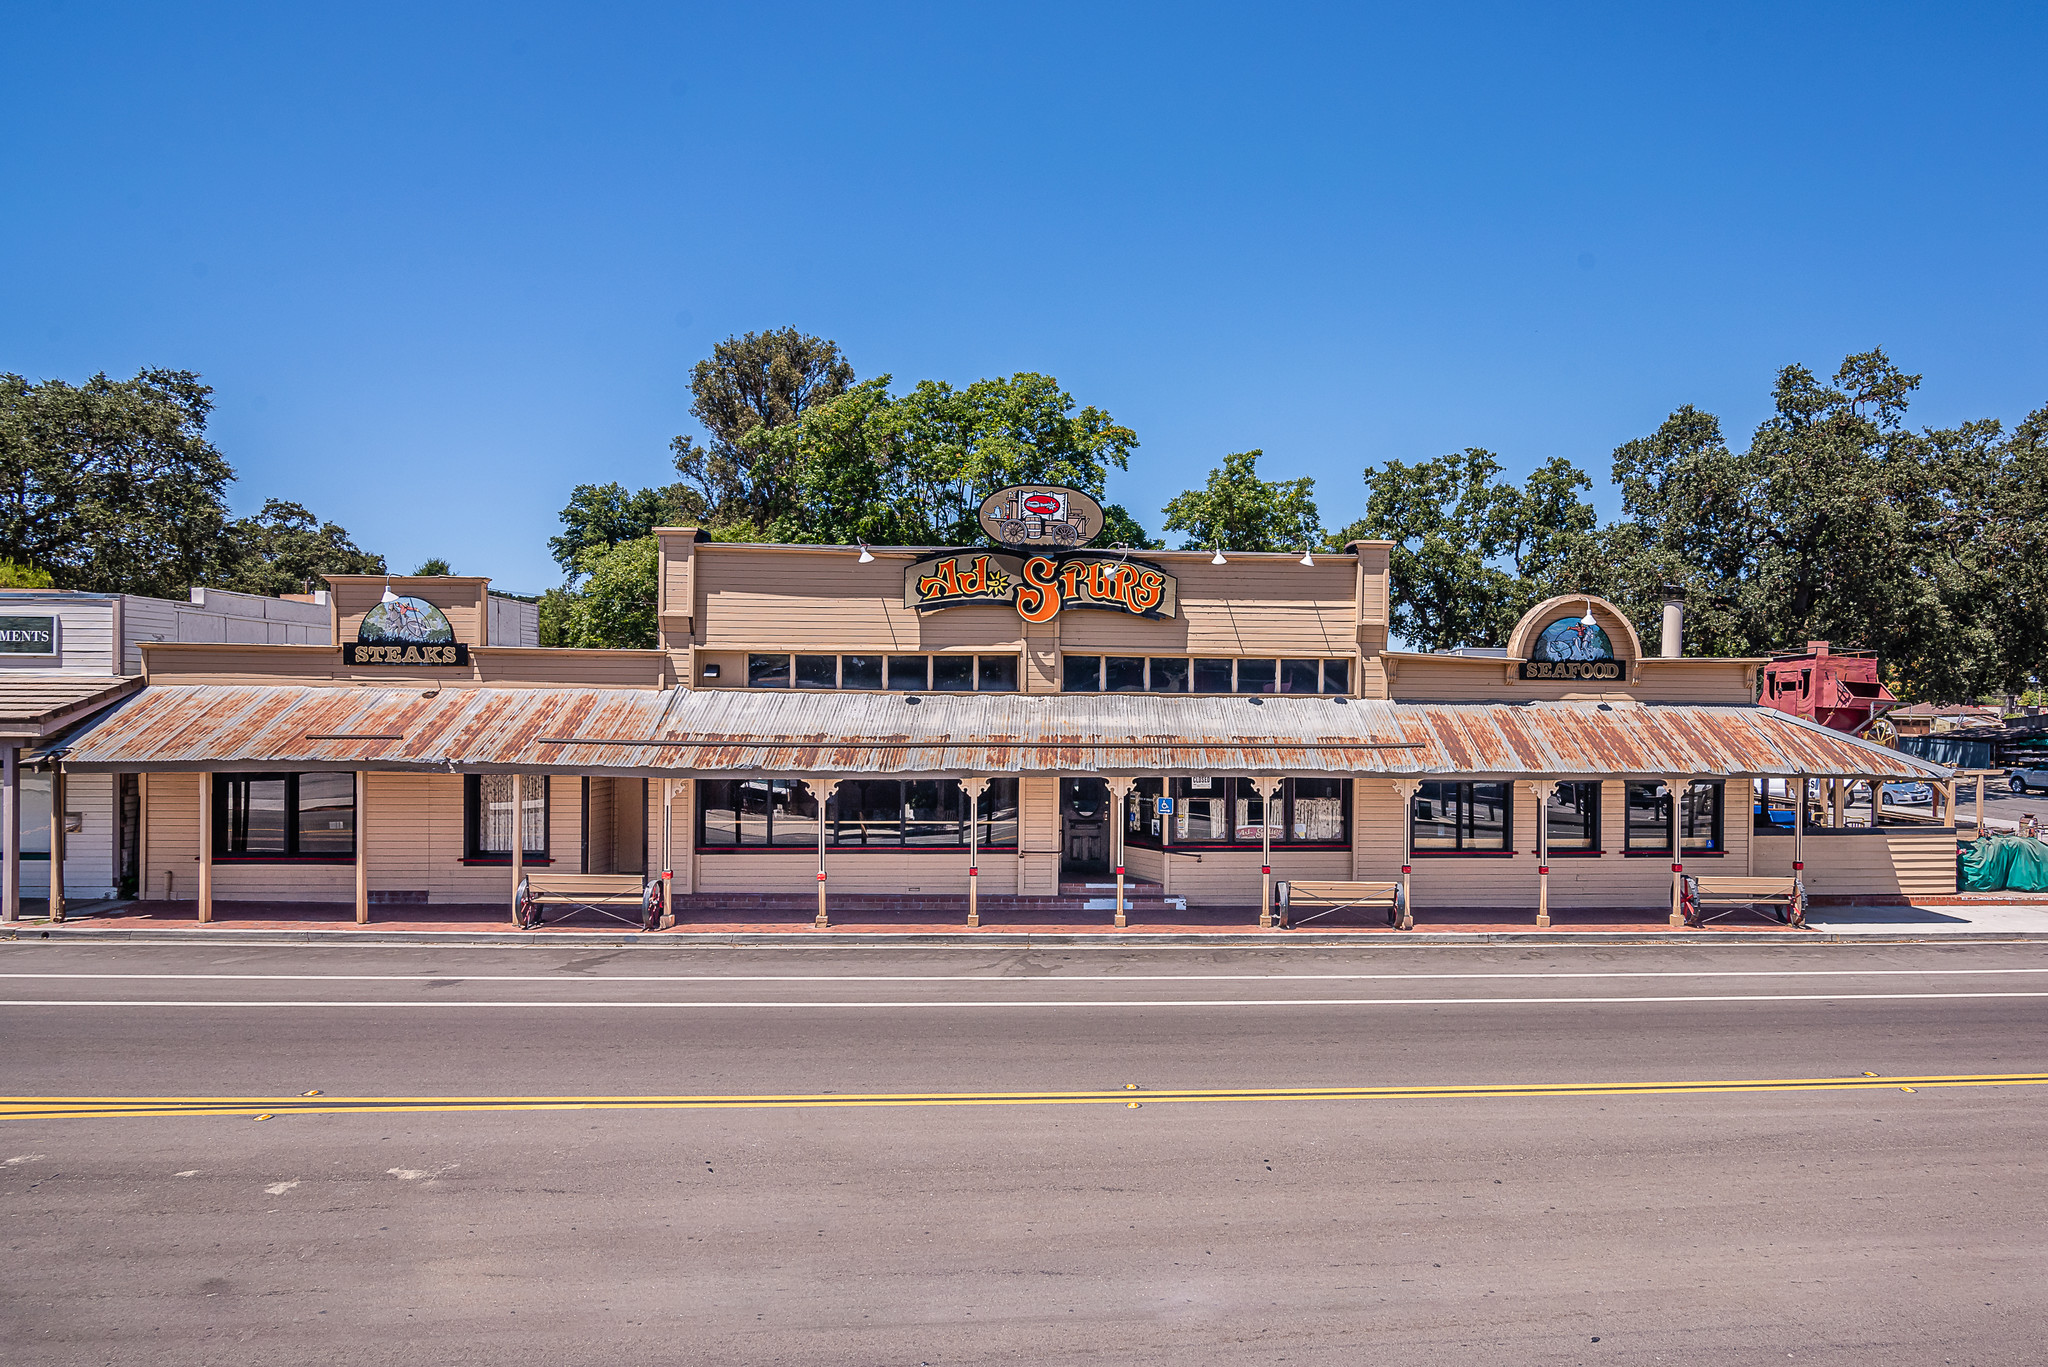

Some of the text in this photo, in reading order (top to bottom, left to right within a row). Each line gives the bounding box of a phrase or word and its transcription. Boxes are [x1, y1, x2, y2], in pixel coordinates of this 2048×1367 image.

[0, 630, 49, 642] MENTS
[354, 645, 457, 664] STEAKS
[1526, 662, 1620, 679] SEAFOOD
